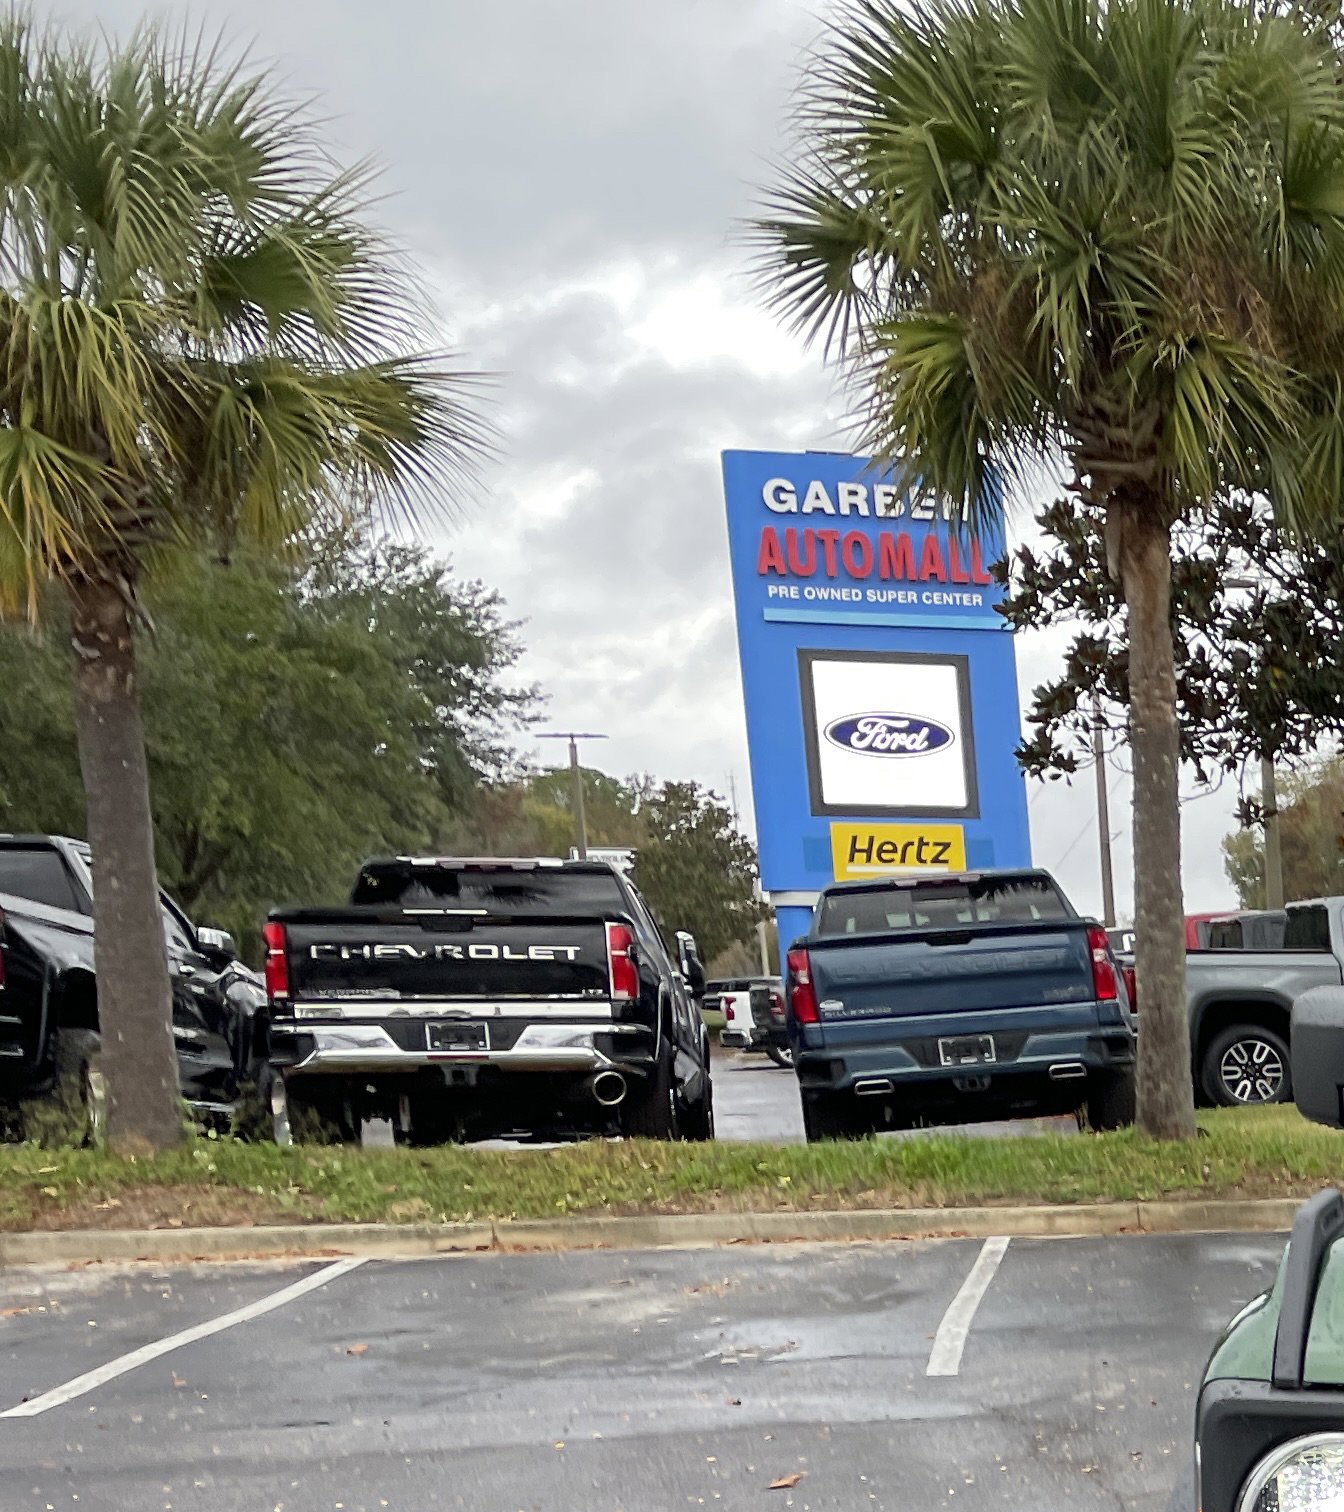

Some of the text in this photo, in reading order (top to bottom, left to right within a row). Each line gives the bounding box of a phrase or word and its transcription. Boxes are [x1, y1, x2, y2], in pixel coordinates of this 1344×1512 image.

[768, 585, 983, 608] PRE OWNED SUPER CENTER
[848, 835, 952, 865] Hertz
[310, 944, 581, 960] CHEVROLET
